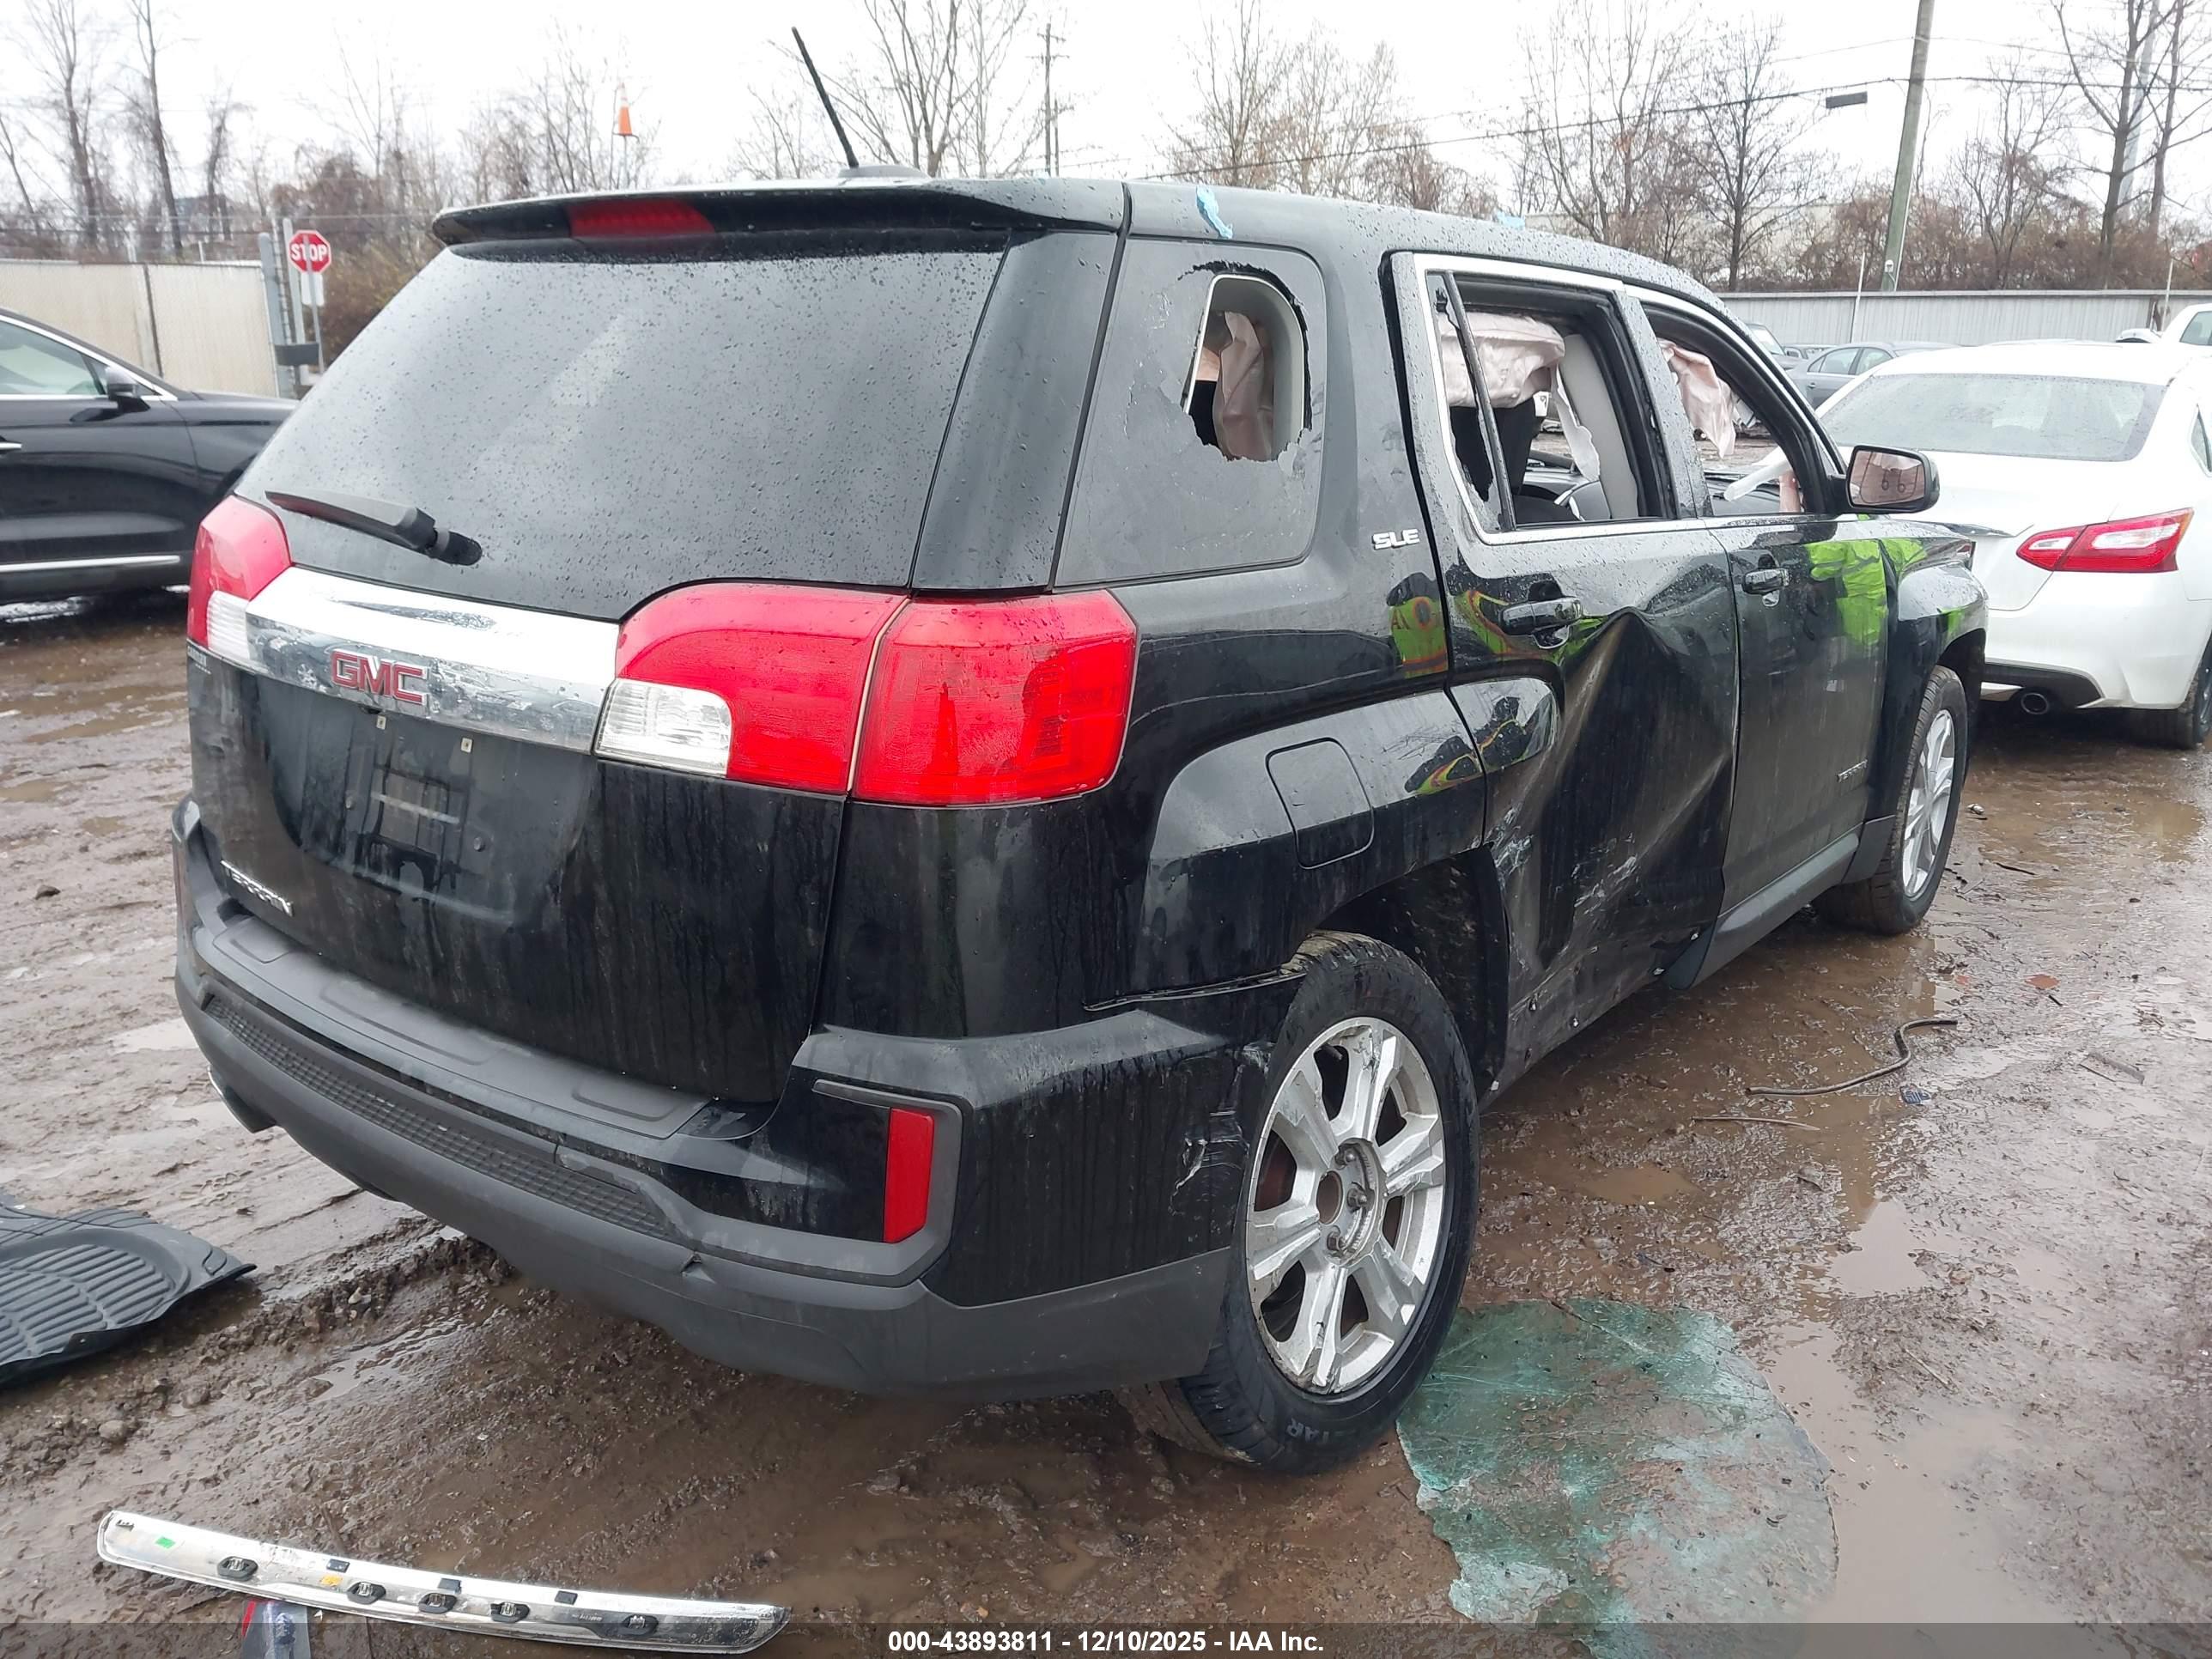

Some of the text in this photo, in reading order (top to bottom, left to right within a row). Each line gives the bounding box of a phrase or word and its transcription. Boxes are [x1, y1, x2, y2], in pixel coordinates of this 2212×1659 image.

[290, 243, 328, 263] STOP
[1372, 528, 1420, 550] SLE
[331, 648, 430, 707] GMC
